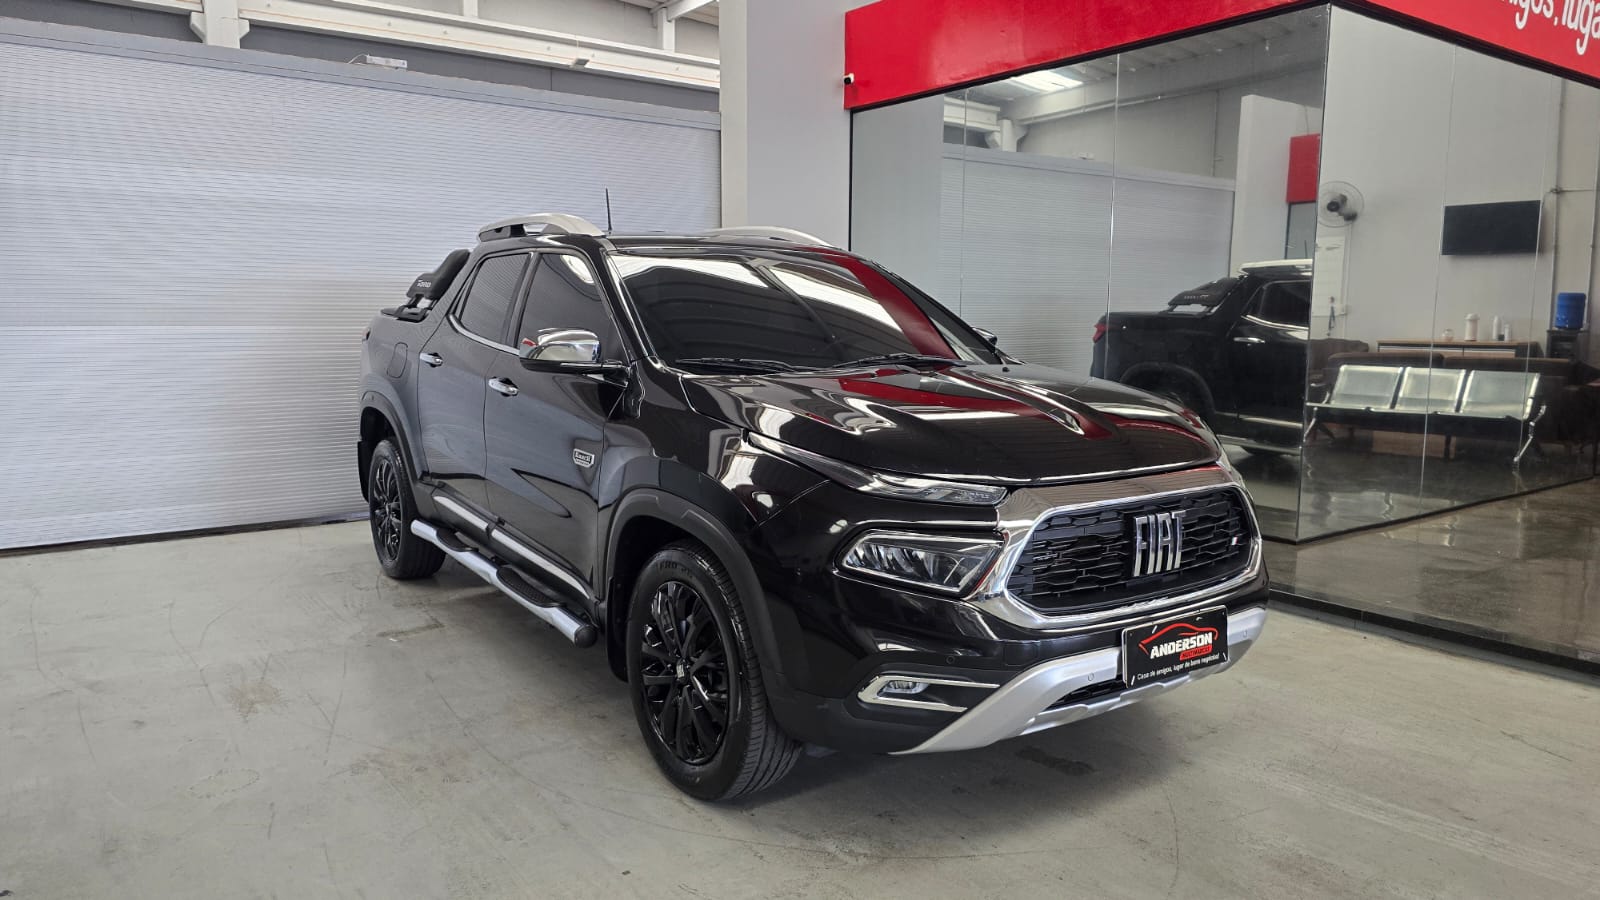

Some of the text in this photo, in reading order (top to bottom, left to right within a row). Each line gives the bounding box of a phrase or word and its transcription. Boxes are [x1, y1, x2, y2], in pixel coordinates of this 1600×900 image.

[1133, 510, 1186, 577] FIAT
[1150, 632, 1213, 659] ANDERSON
[1137, 672, 1149, 680] Casa
